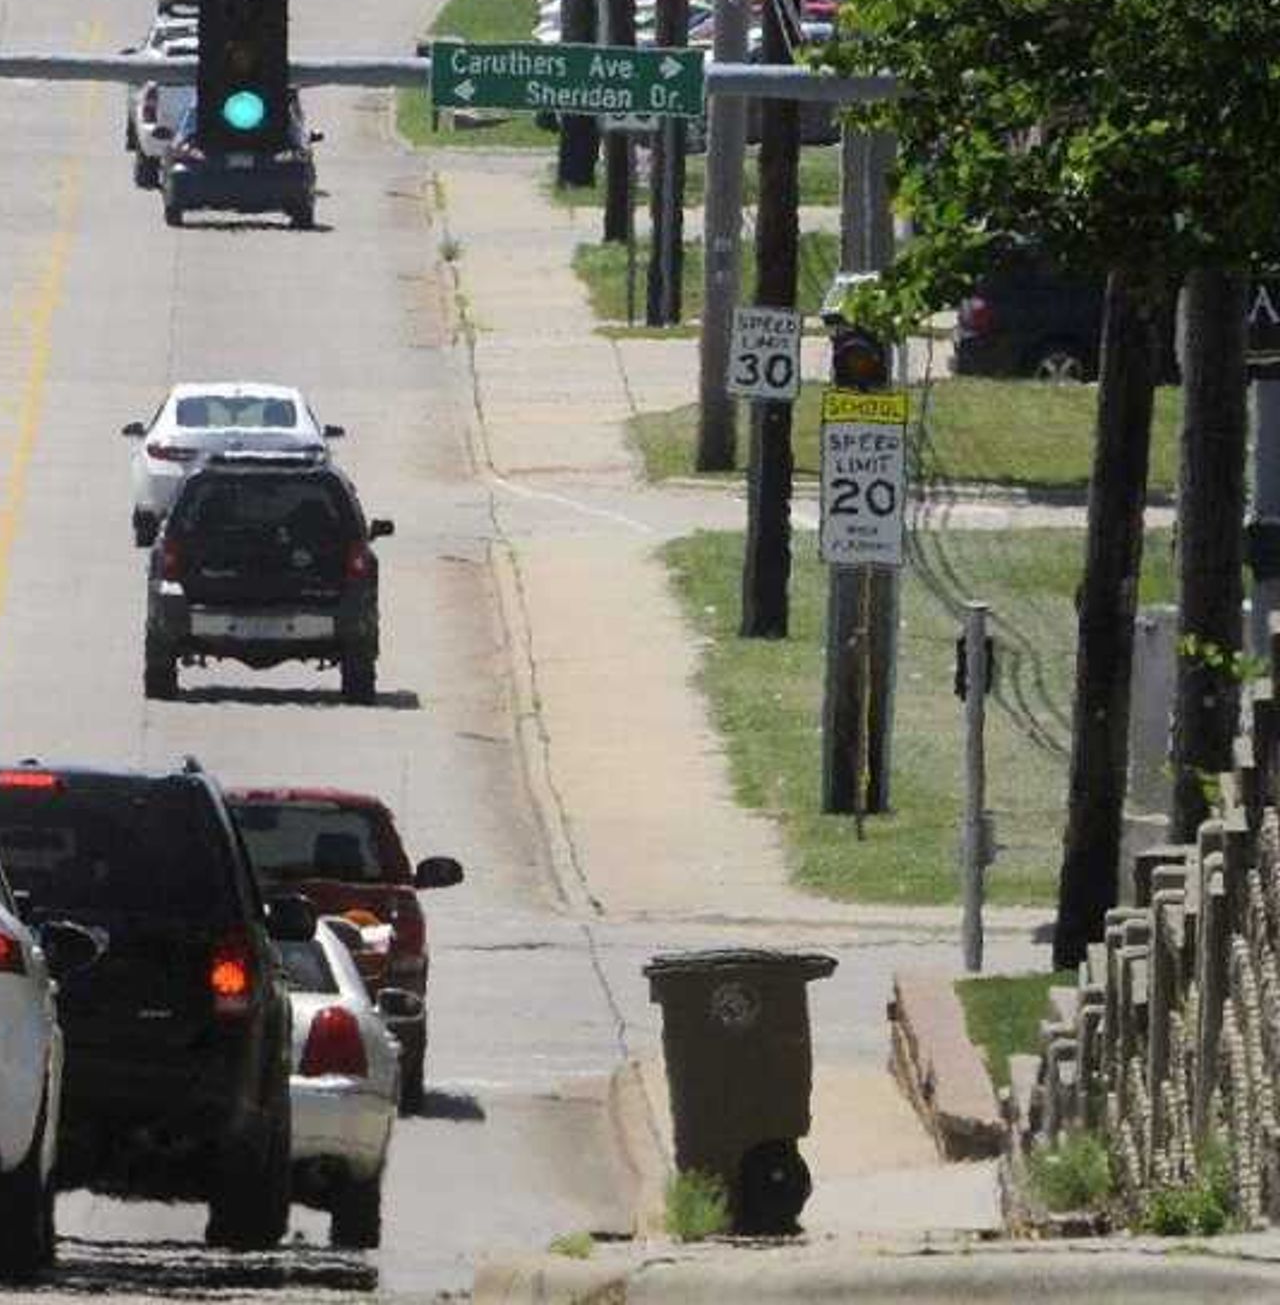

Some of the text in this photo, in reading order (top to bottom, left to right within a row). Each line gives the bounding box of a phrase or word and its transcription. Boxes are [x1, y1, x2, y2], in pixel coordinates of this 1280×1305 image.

[450, 47, 567, 77] Caruthers
[526, 80, 633, 109] Sheridan
[739, 314, 795, 334] SPEED
[734, 353, 792, 389] 30
[829, 396, 900, 418] SCHOOL
[829, 433, 899, 451] SPEED
[837, 456, 894, 475] LIMIT
[829, 477, 897, 516] 20
